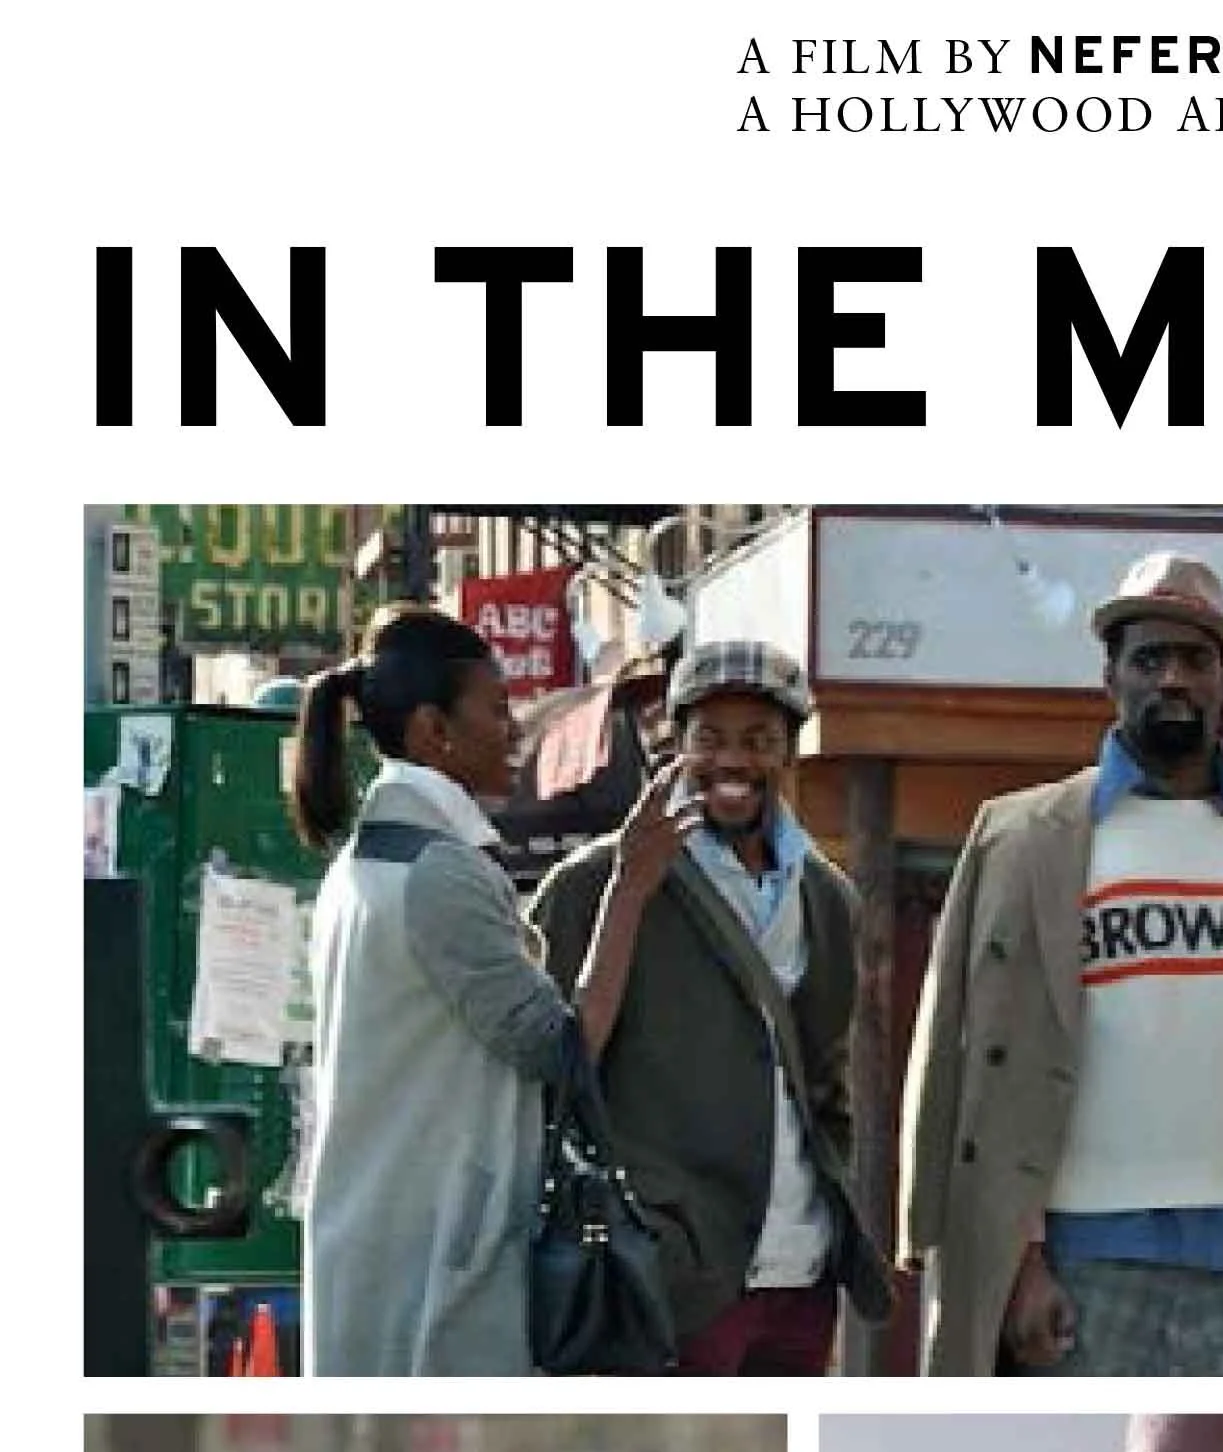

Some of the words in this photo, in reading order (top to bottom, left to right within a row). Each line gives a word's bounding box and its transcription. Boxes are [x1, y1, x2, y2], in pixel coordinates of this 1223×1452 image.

[737, 38, 770, 73] A
[792, 40, 922, 74] FILM
[946, 40, 1010, 73] BY
[737, 96, 770, 131] A
[792, 97, 1151, 132] HOLLYWOOD
[96, 247, 326, 426] IN
[435, 247, 926, 426] THE
[846, 618, 919, 659] 229
